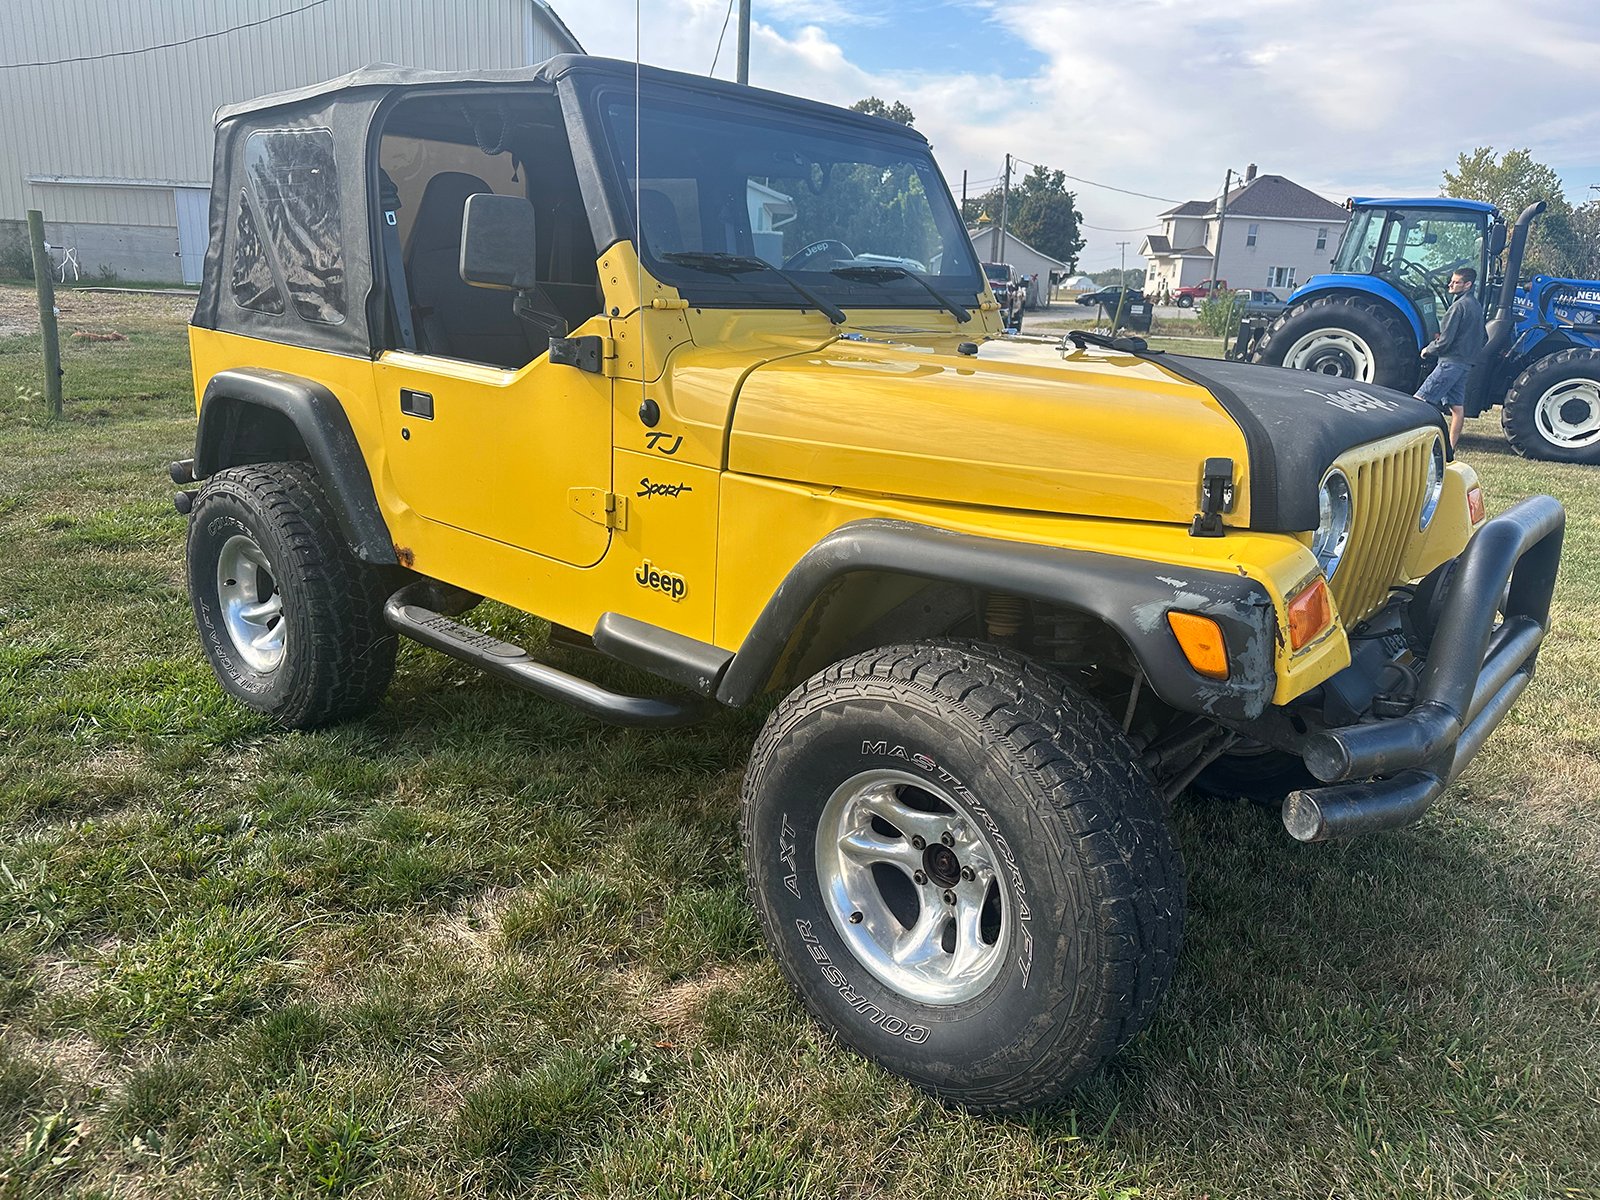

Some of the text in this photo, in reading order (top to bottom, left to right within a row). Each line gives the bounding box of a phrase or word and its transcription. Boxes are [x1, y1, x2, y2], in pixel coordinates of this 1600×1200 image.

[805, 242, 829, 257] Jeep
[645, 431, 684, 455] TJ
[636, 477, 693, 500] Sport
[635, 561, 686, 600] Jeep
[860, 739, 1034, 990] MASTERCRAFT
[780, 812, 932, 1045] COURSER AXT
